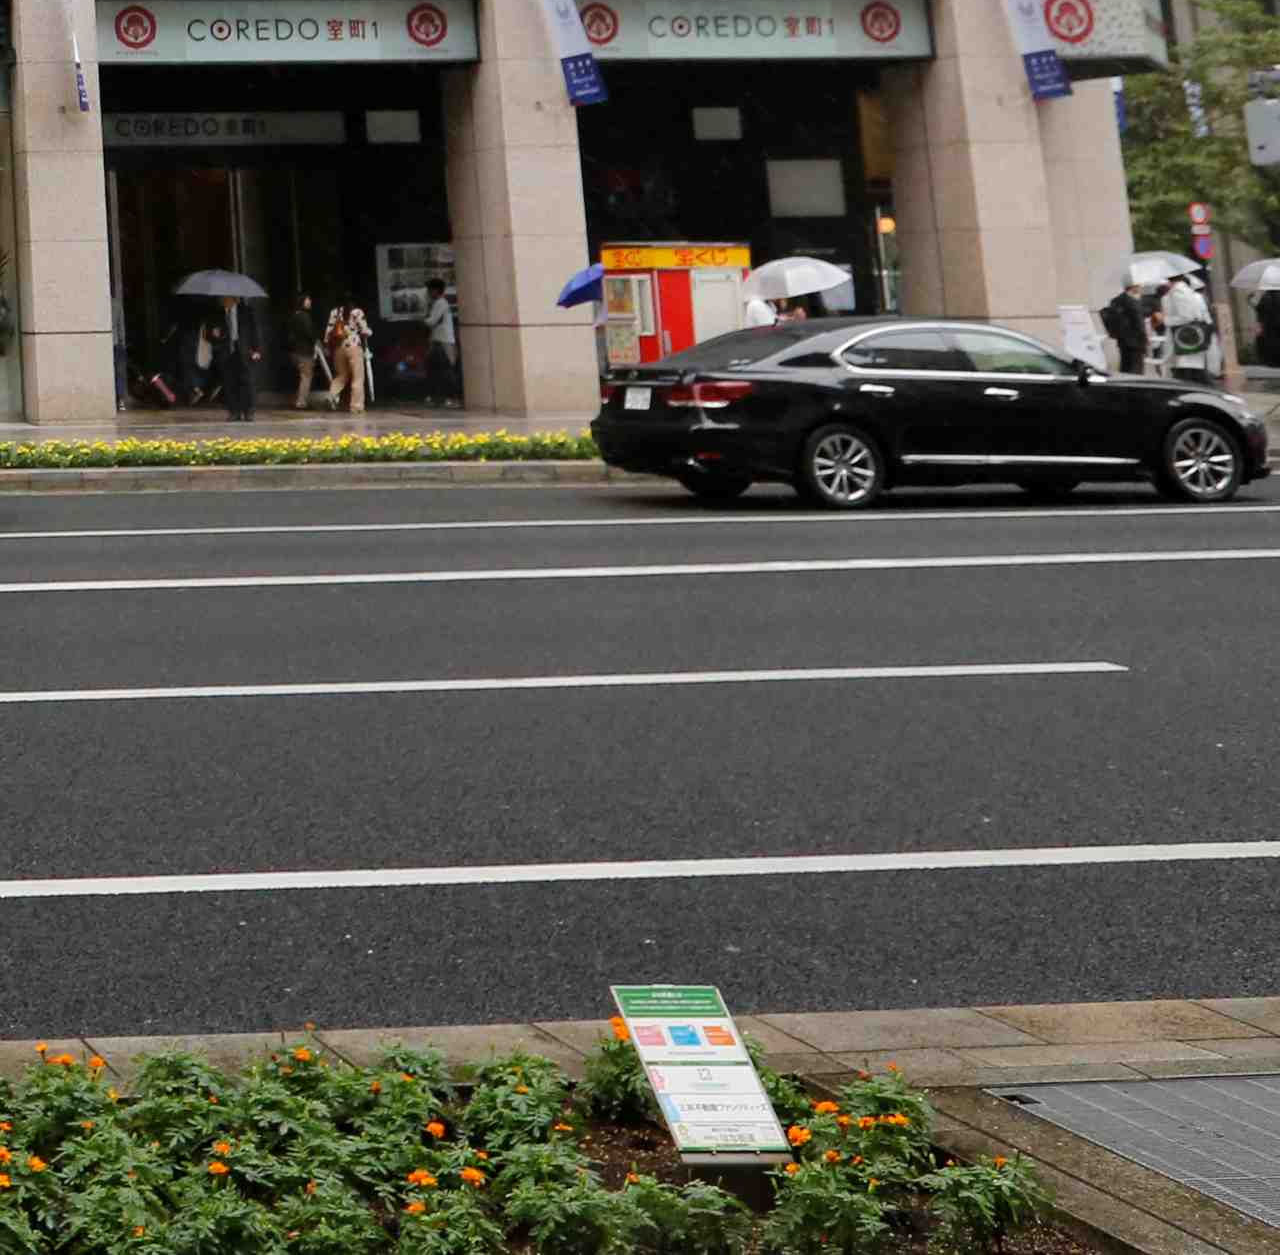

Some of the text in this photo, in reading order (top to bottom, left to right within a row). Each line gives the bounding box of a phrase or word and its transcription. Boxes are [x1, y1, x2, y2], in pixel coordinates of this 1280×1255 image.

[187, 18, 380, 42] COREDO 室町1
[648, 14, 777, 38] COREDO
